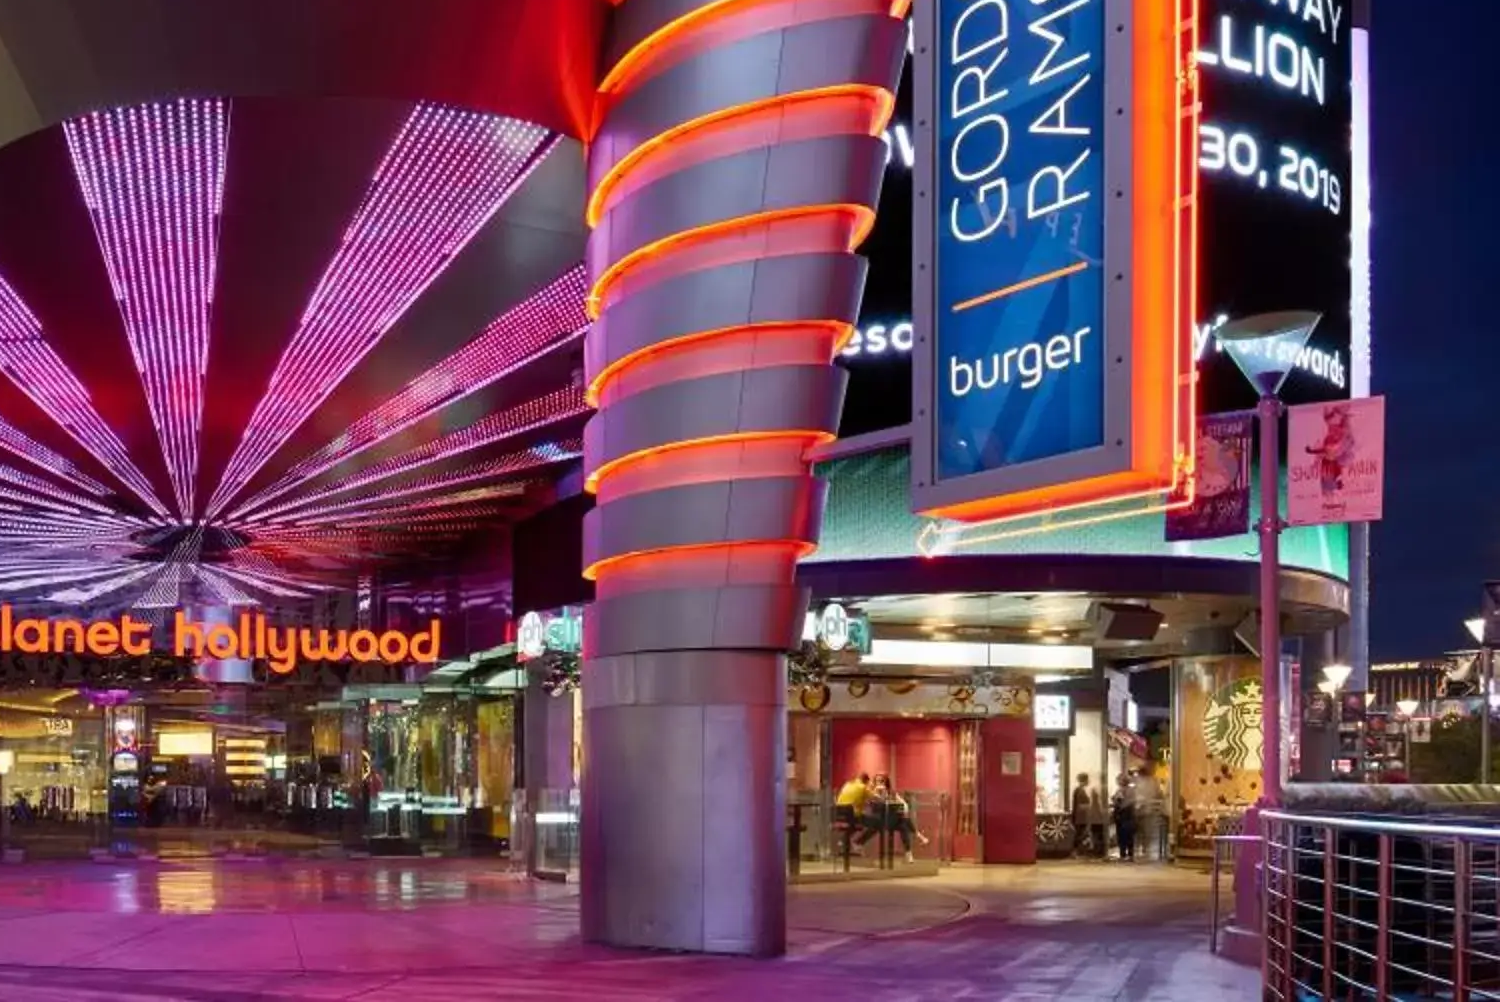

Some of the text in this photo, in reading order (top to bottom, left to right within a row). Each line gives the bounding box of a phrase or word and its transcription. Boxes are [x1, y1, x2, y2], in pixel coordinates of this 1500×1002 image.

[1197, 15, 1325, 105] LION
[1199, 125, 1341, 215] 30, 2019
[950, 328, 1092, 396] burger
[175, 610, 440, 673] hollywood
